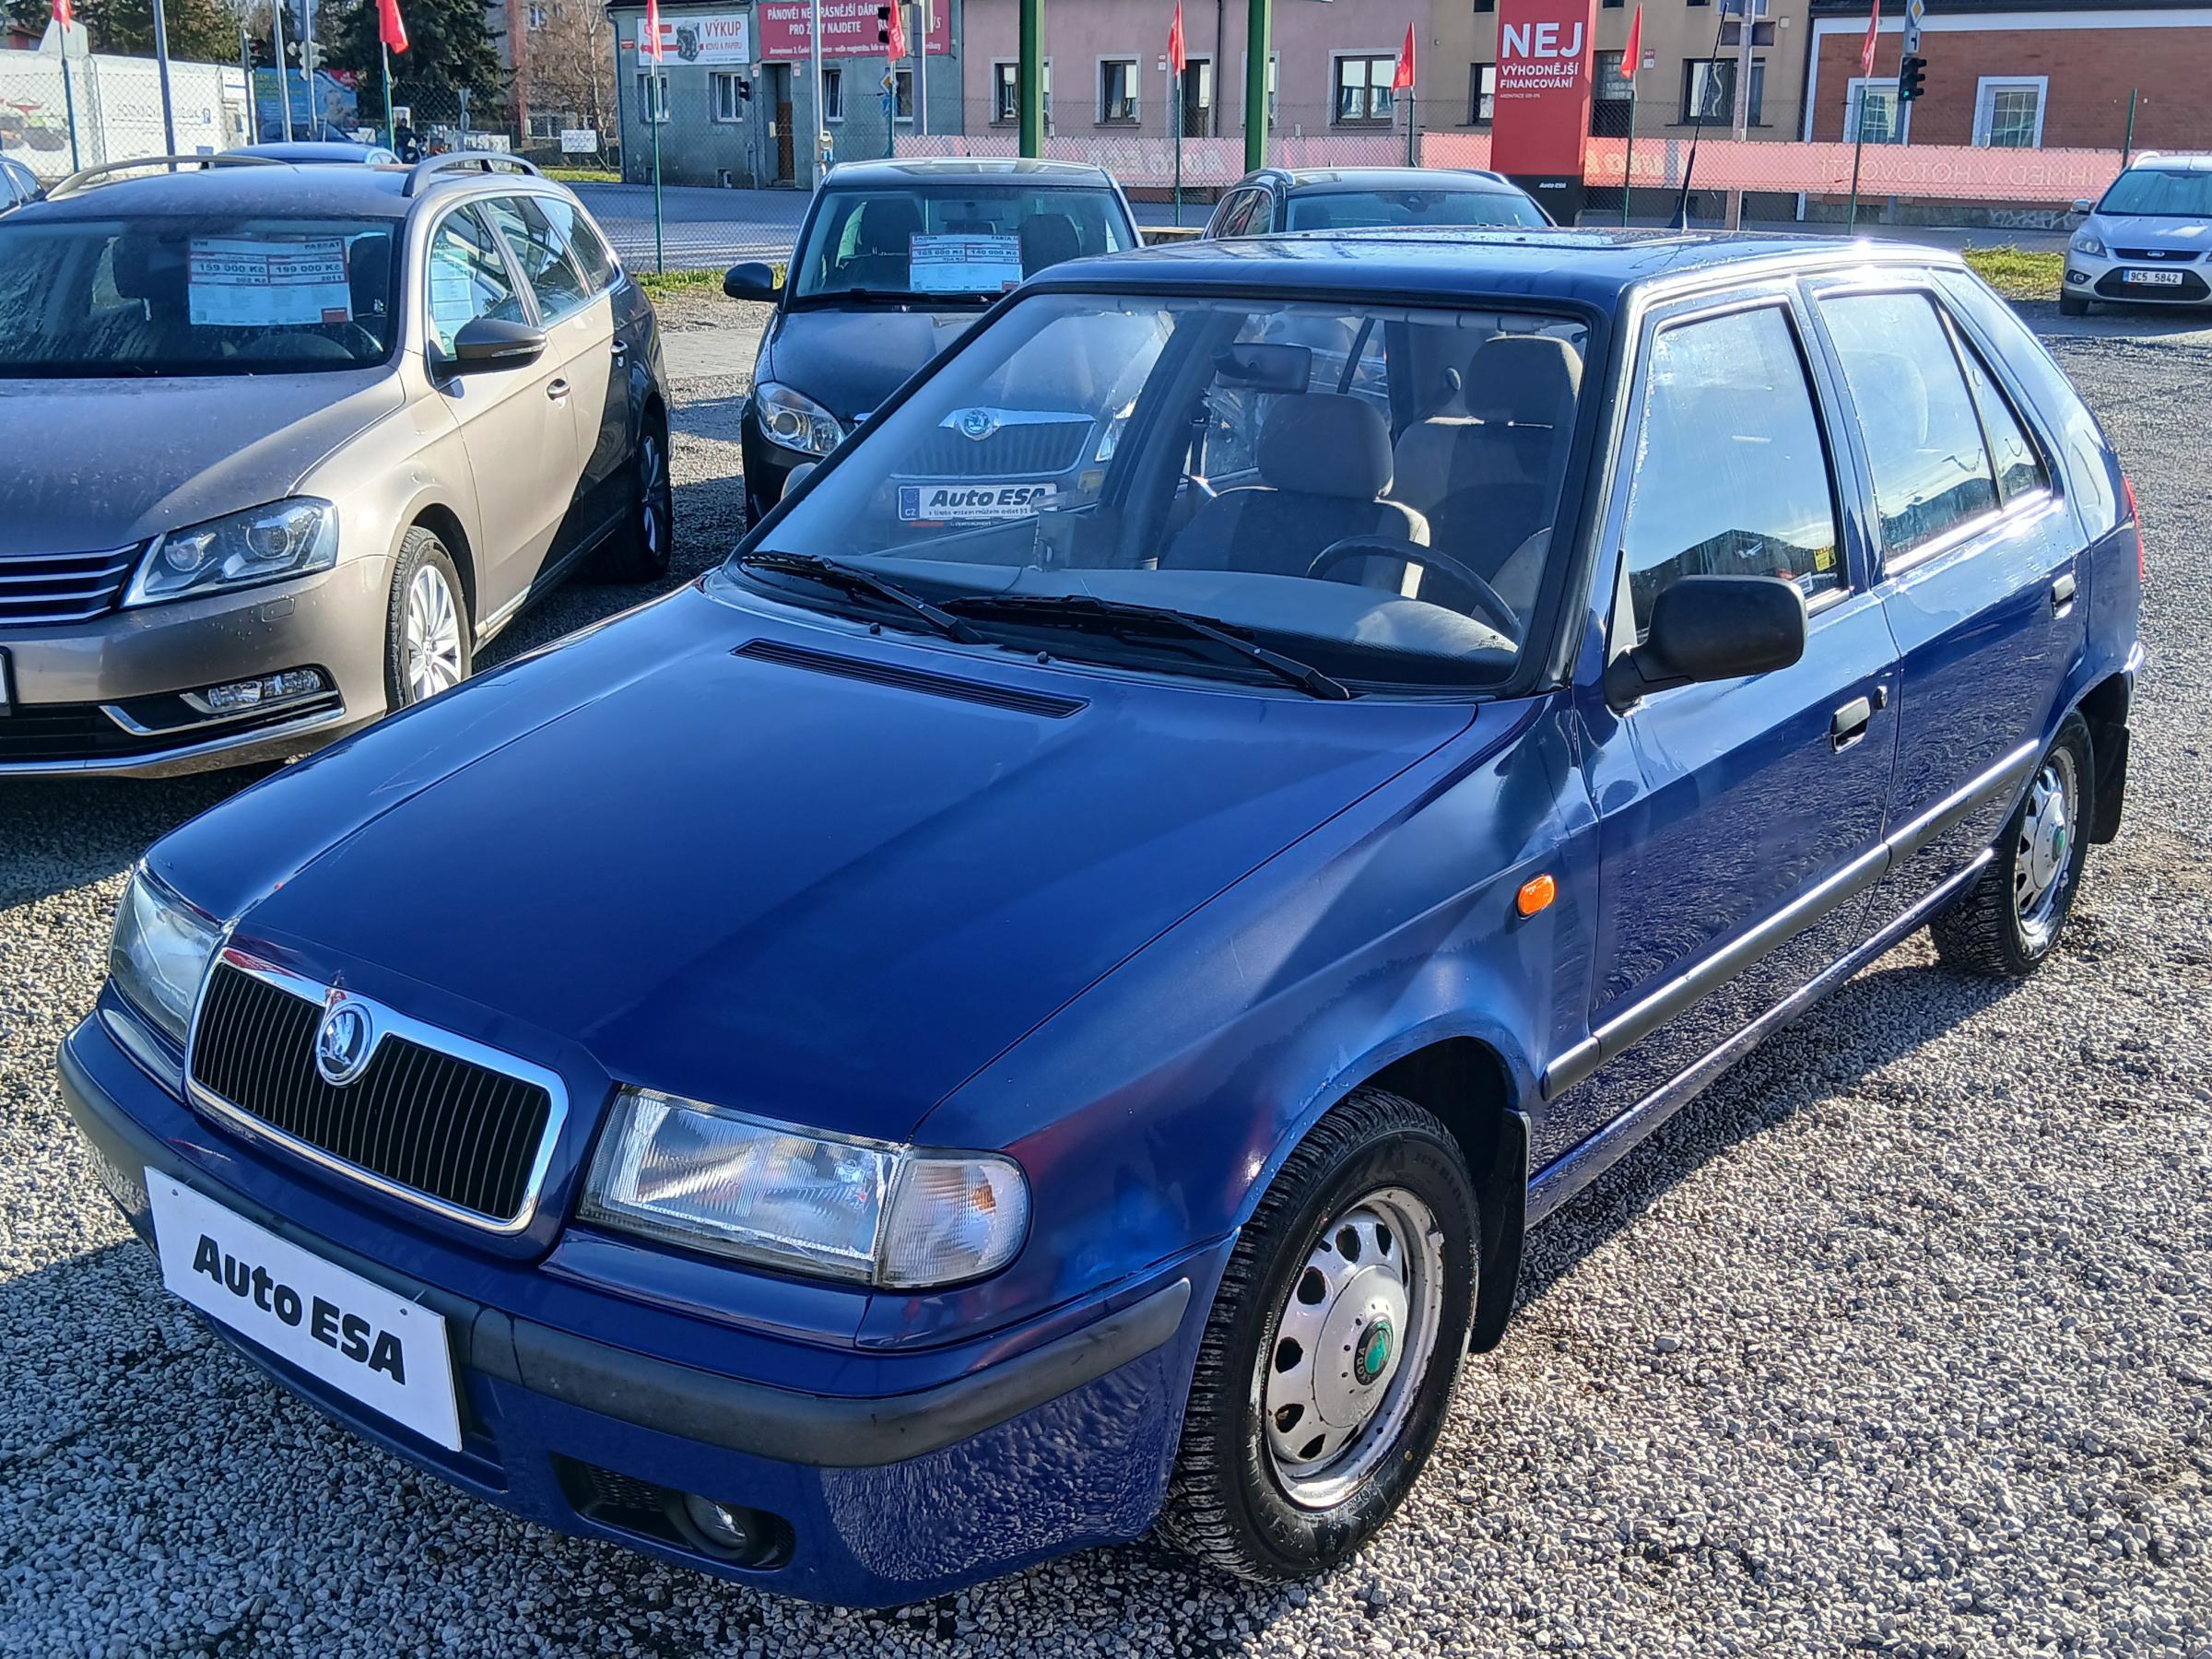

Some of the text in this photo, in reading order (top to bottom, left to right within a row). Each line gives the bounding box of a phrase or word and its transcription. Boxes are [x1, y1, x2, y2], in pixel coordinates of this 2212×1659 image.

[801, 3, 856, 18] NERÁSNĚJŠÍ
[705, 19, 742, 38] VÝKUP
[789, 20, 862, 35] PRO ŽY NAJDETE
[1501, 22, 1583, 58] NEJ
[1501, 62, 1579, 76] VÝHODNĚJŠÍ
[1500, 76, 1573, 88] FINANCOVÁNÍ
[225, 264, 246, 273] 000
[300, 264, 322, 272] 000
[2131, 272, 2178, 283] 9C5 5842
[929, 489, 994, 507] Auto
[193, 1233, 406, 1386] Auto ESA
